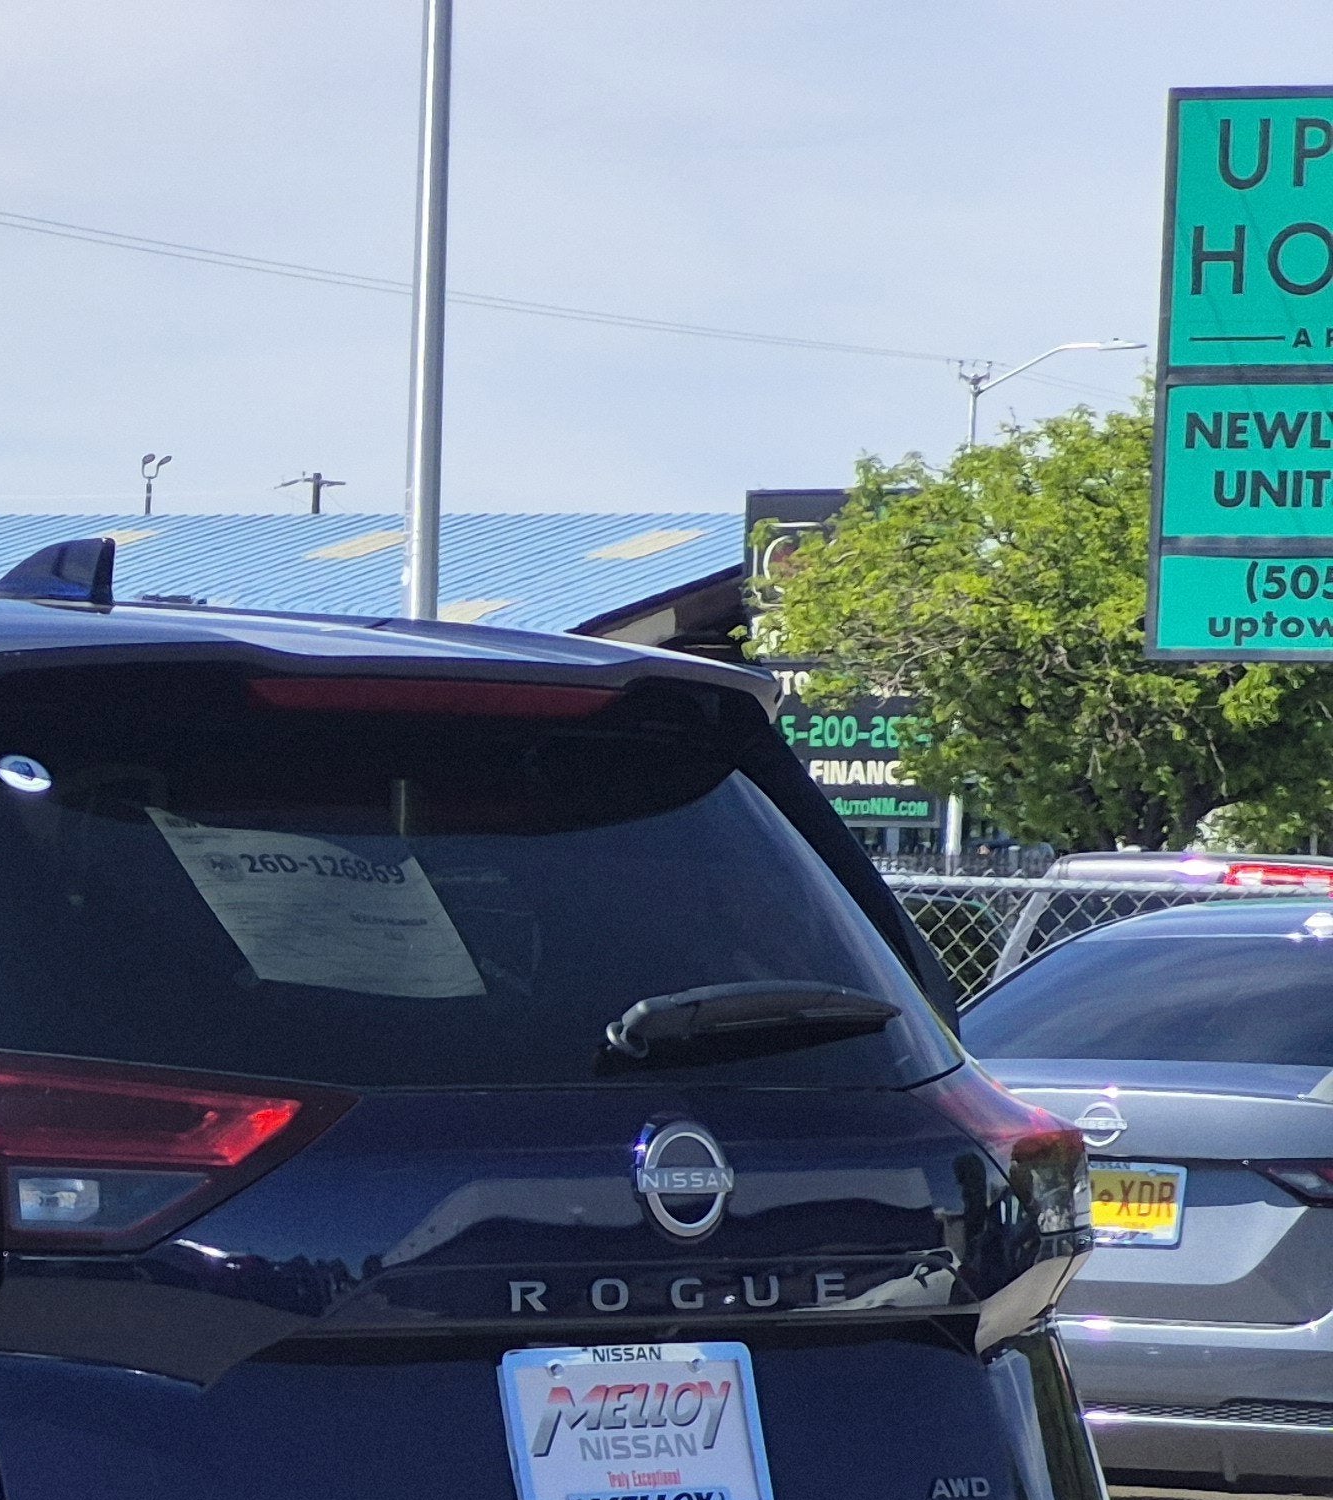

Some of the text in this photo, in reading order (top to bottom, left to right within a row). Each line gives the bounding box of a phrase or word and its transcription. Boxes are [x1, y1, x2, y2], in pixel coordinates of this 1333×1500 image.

[1190, 222, 1333, 295] HO
[1185, 411, 1333, 449] NEWL
[642, 1170, 733, 1190] NISSAN
[509, 1273, 846, 1312] ROGUE
[592, 1346, 662, 1363] NISSAN
[533, 1380, 731, 1457] MELLOY
[579, 1433, 698, 1461] NISSAN
[932, 1477, 990, 1499] AWD
